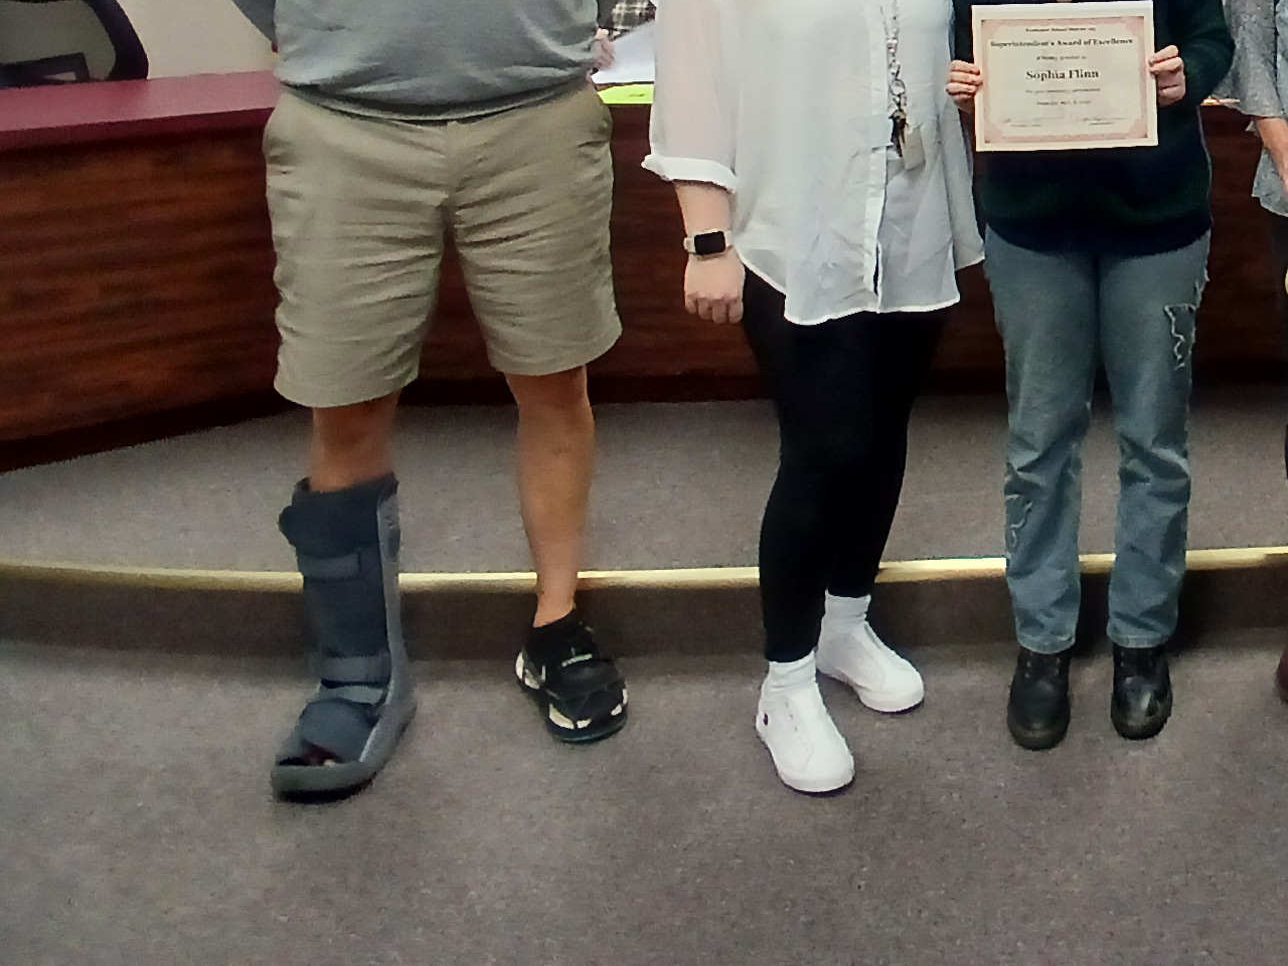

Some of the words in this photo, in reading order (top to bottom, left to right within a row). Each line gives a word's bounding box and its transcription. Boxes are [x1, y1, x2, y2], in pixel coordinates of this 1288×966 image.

[1057, 38, 1081, 46] Award
[1083, 38, 1093, 46] of
[1093, 37, 1133, 46] Excellence
[1025, 70, 1066, 81] Sophia
[1068, 68, 1099, 79] Flinn
